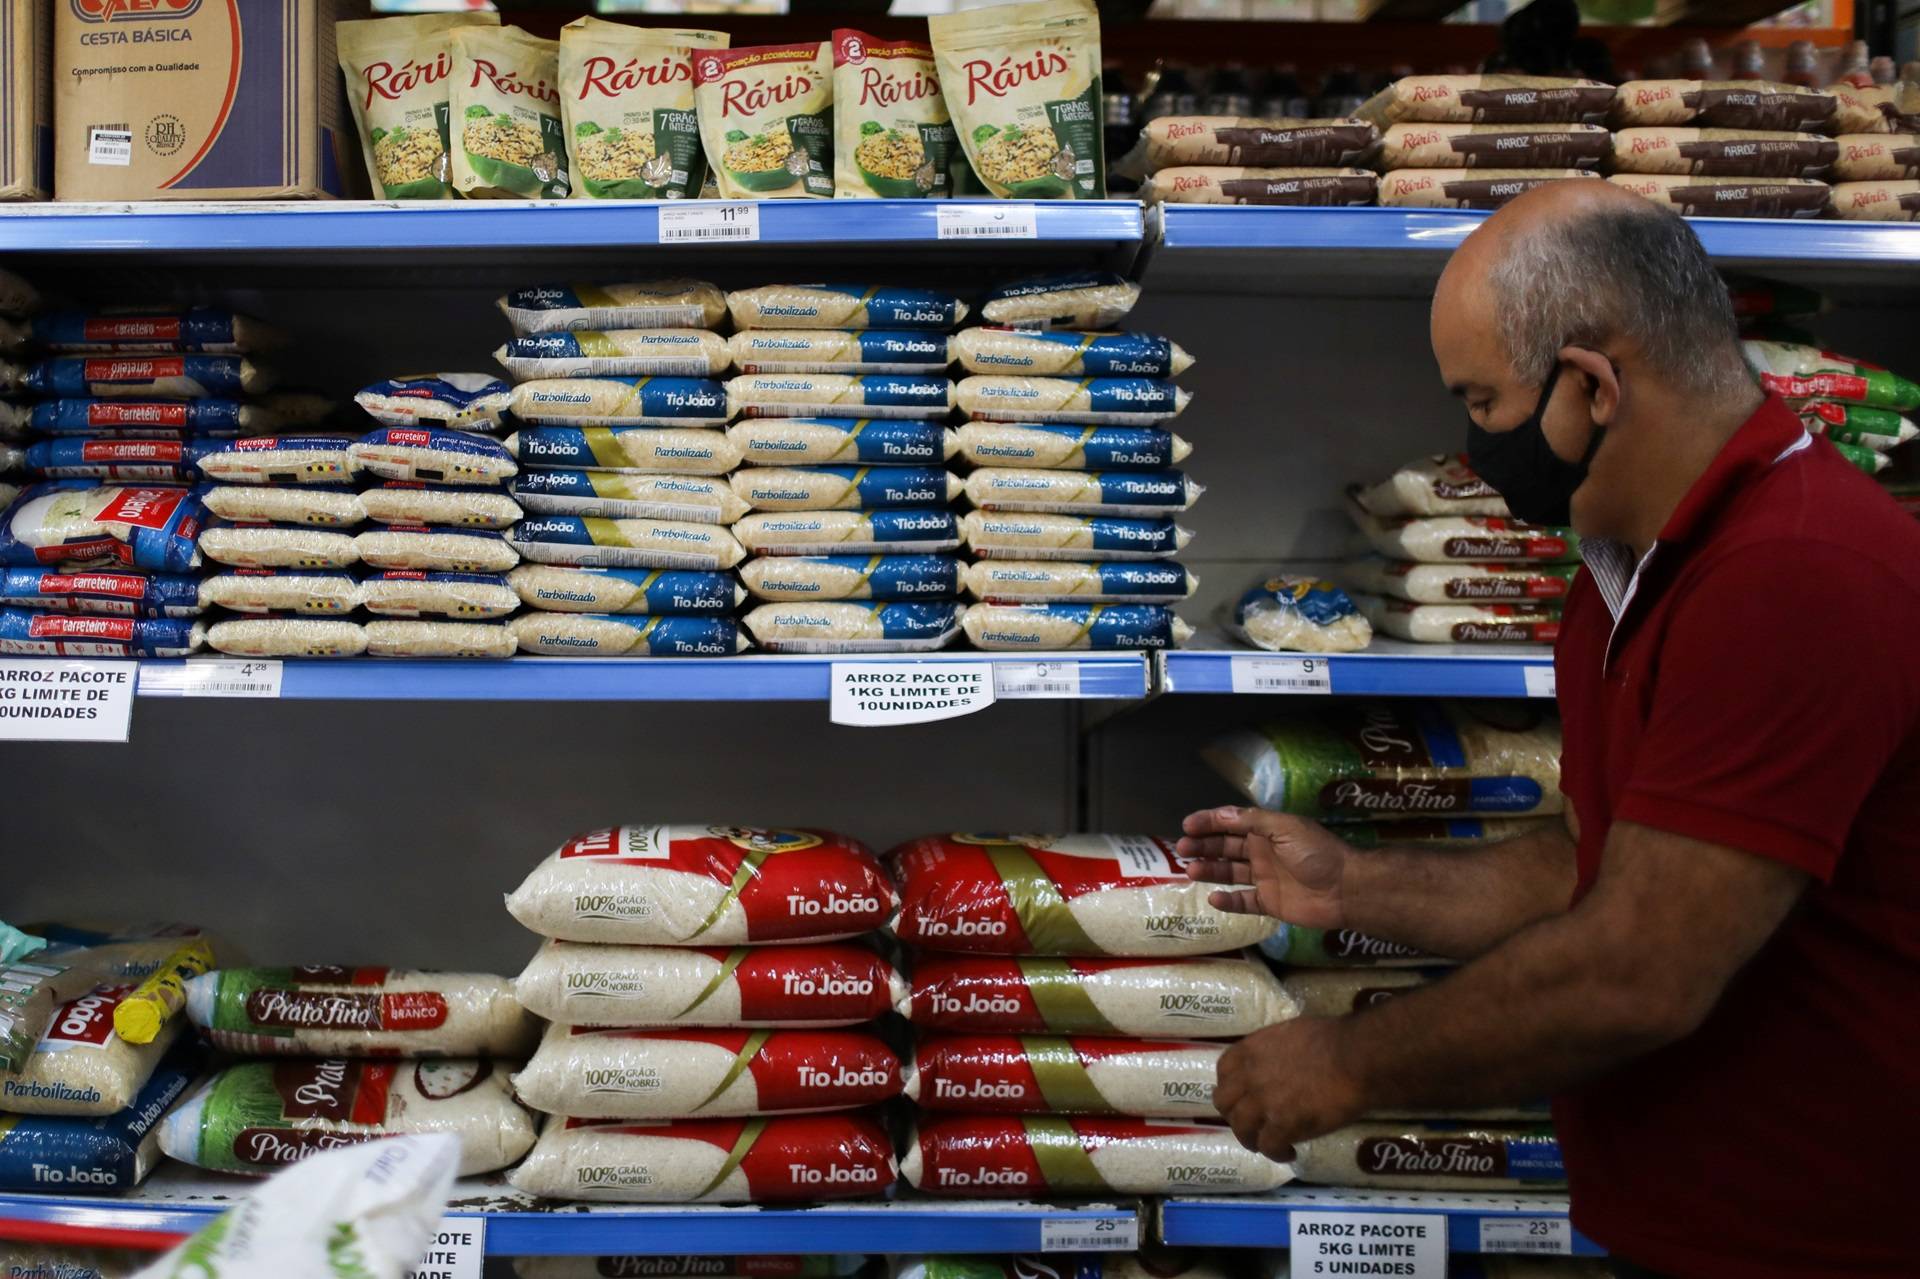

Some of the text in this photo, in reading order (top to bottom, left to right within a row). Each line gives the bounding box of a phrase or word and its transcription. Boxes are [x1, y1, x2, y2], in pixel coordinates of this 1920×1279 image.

[80, 27, 192, 46] CESTA BÁSICA
[849, 41, 860, 56] 2
[705, 61, 718, 74] 2
[363, 52, 452, 111] Rári
[579, 57, 692, 100] Ráris
[962, 50, 1068, 106] Ráris
[859, 67, 940, 107] Ráris
[721, 76, 811, 117] Ráris
[1505, 92, 1538, 104] ARROZ
[1727, 94, 1756, 106] ARROZ
[441, 107, 449, 125] 7
[1051, 106, 1059, 123] 7
[1060, 101, 1089, 113] GRÃOS
[545, 119, 552, 133] 7
[660, 114, 667, 130] 7
[791, 120, 798, 133] 7
[922, 130, 928, 141] 7
[1497, 136, 1529, 149] ARROZ
[1724, 144, 1756, 156] ARROZ
[1267, 181, 1299, 194] ARROZ
[1491, 183, 1522, 196] ARROZ
[1716, 188, 1748, 200] ARROZ
[535, 288, 563, 300] João
[894, 309, 943, 321] Tio João
[114, 322, 154, 334] carreteiro
[536, 337, 565, 348] João
[906, 341, 936, 352] João
[975, 354, 1033, 366] Parboilizado
[1109, 361, 1159, 373] Tio João
[666, 394, 716, 407] Tio João
[1135, 390, 1164, 401] João
[120, 408, 160, 420] carreteiro
[391, 432, 426, 441] carreteiro
[114, 444, 156, 456] carreteiro
[529, 442, 578, 455] Tio João
[655, 447, 712, 459] Parboilizado
[883, 443, 933, 455] Tio João
[976, 446, 1034, 457] Parboilizado
[1111, 452, 1160, 464] Tio João
[546, 474, 577, 485] João
[886, 489, 935, 500] Tio João
[1144, 483, 1176, 494] João
[543, 521, 574, 532] João
[652, 528, 711, 542] Parboilizado
[1119, 528, 1136, 539] Tio
[73, 579, 118, 590] carreteiro
[1145, 572, 1176, 584] João
[762, 581, 820, 592] Parboilizado
[915, 581, 945, 592] João
[1492, 579, 1521, 596] Fino
[537, 589, 595, 602] Parboilizado
[673, 596, 723, 608] Tio João
[62, 620, 106, 632] carreteiro
[1499, 624, 1527, 640] Fino
[540, 636, 598, 647] Parboilizado
[675, 641, 725, 653] Tio João
[59, 671, 127, 683] PACOTE
[845, 674, 982, 683] ARROZ PACOTE
[23, 689, 81, 701] LIMITE
[87, 689, 109, 701] DE
[848, 686, 980, 696] 1KG LIMITE DE
[858, 699, 971, 711] 10UNIDADES
[1335, 782, 1456, 810] Prato Fino
[574, 895, 615, 912] 100%
[616, 905, 651, 915] NOBRES
[787, 894, 879, 915] Tio João
[917, 917, 1006, 936] Tio João
[1145, 916, 1185, 931] 100%
[567, 972, 608, 990] 100%
[782, 973, 873, 995] Tio João
[260, 993, 438, 1024] Prato Fino BRANCO
[932, 993, 1020, 1013] Tio João
[1159, 995, 1200, 1011] 100%
[584, 1068, 625, 1085] 100%
[798, 1066, 888, 1086] Tio João
[4, 1081, 101, 1103] Parboilizado
[935, 1078, 1025, 1098] Tio João
[1163, 1082, 1203, 1097] 100%
[1373, 1142, 1494, 1172] Prato Fino
[32, 1164, 117, 1185] Tio João
[577, 1167, 617, 1183] 100%
[789, 1164, 877, 1183] Tio João
[939, 1167, 1027, 1186] Tio João
[1167, 1167, 1207, 1182] 100%
[1298, 1223, 1426, 1238] ARROZ PACOTE
[1320, 1242, 1416, 1257] 5KG LIMITE
[1314, 1261, 1415, 1275] 5 UNIDADES
